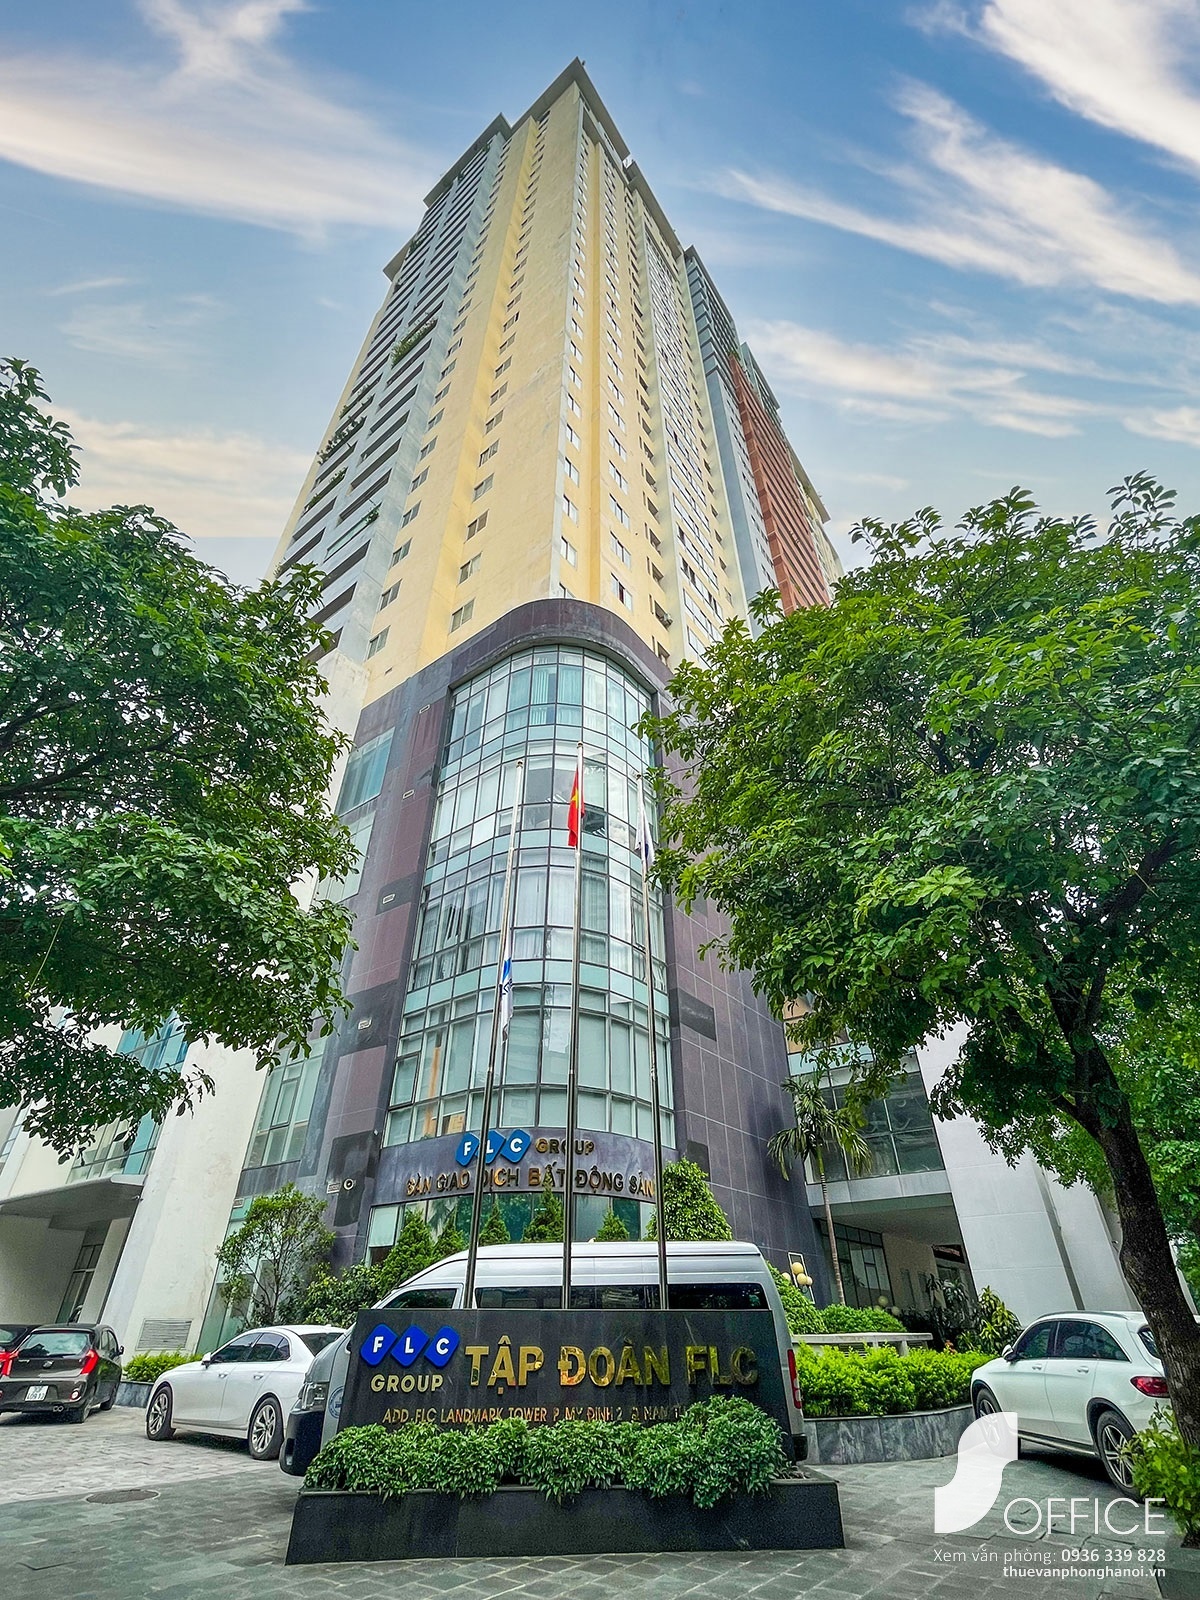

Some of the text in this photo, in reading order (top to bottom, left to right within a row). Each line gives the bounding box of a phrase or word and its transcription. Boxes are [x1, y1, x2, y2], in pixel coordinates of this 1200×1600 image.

[436, 1169, 470, 1193] GIAO
[575, 1165, 624, 1193] ĐỘNG
[372, 1335, 450, 1356] FLC
[465, 1335, 758, 1395] TẬP ĐOÀN FLC
[370, 1374, 443, 1393] GROUP
[440, 1407, 503, 1424] LANDMARK
[508, 1407, 548, 1422] TOWER
